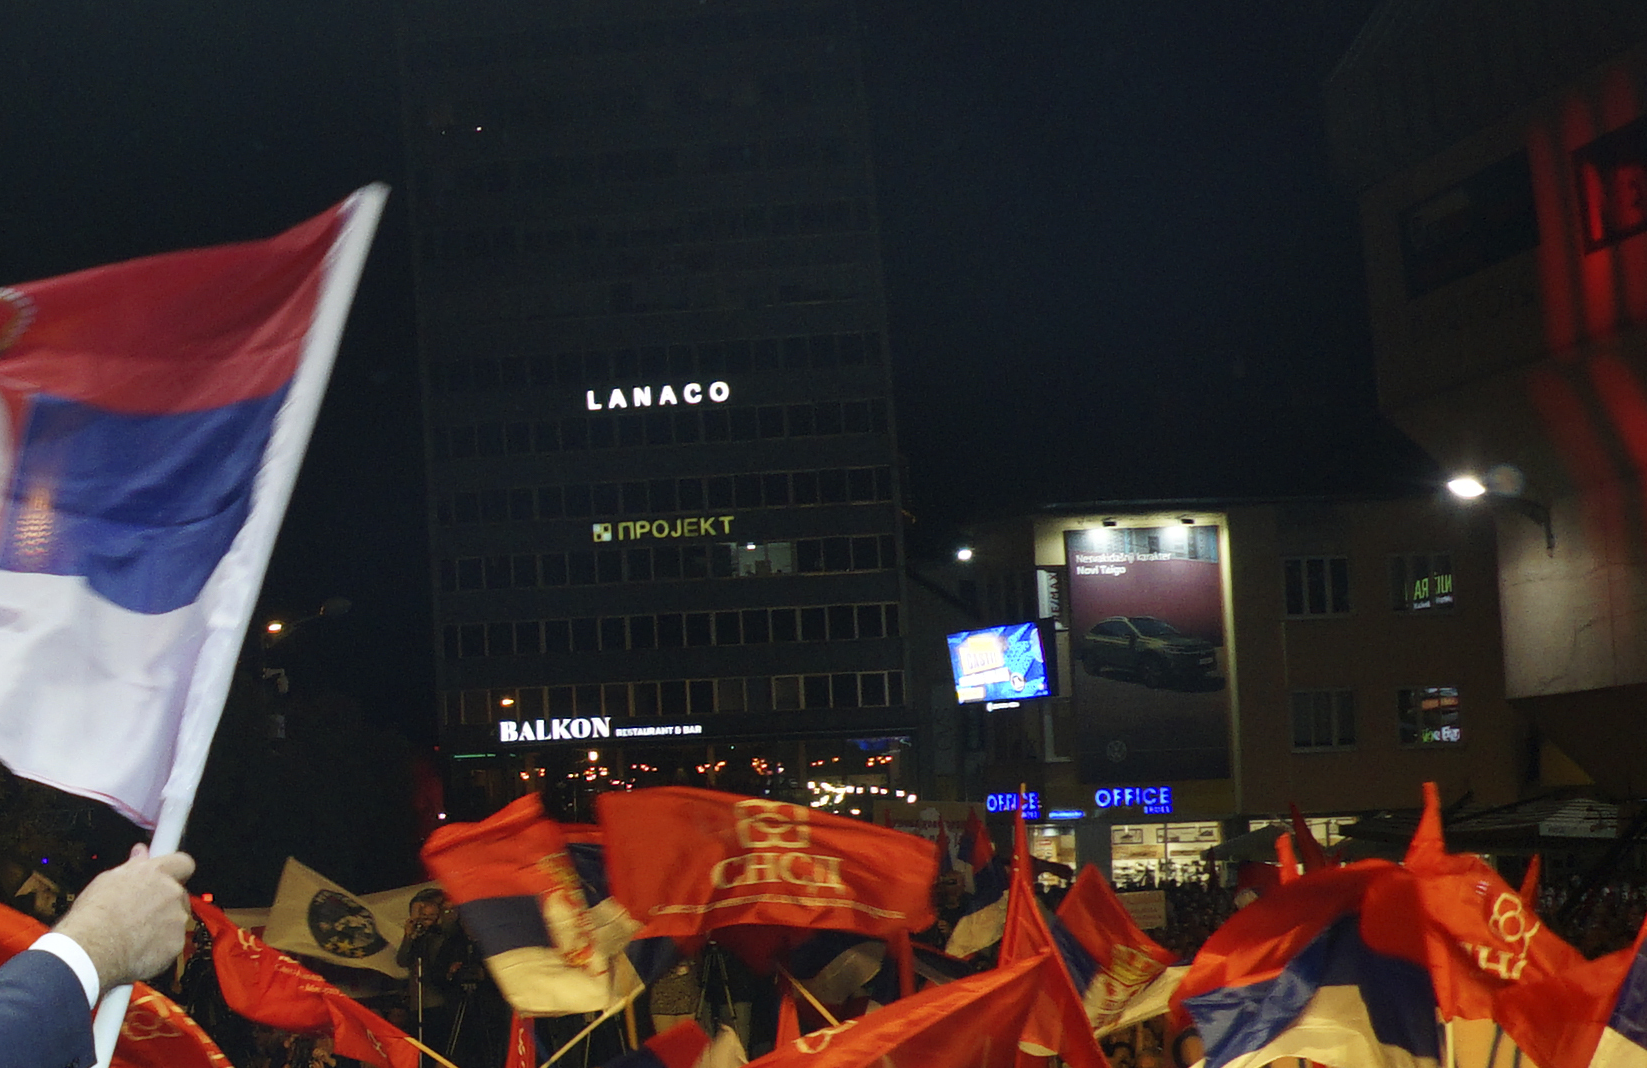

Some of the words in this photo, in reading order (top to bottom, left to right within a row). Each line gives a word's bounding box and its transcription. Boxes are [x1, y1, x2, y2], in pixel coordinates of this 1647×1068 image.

[586, 381, 730, 410] LANACO
[617, 515, 735, 541] ПРОЈЕКТ
[1136, 552, 1172, 562] karakter
[1076, 565, 1099, 576] Novi
[1099, 564, 1127, 577] Taigo
[499, 716, 611, 742] BALKON
[614, 727, 673, 738] RESTAURANT
[682, 725, 702, 734] BAR
[1094, 786, 1173, 808] OFFICE
